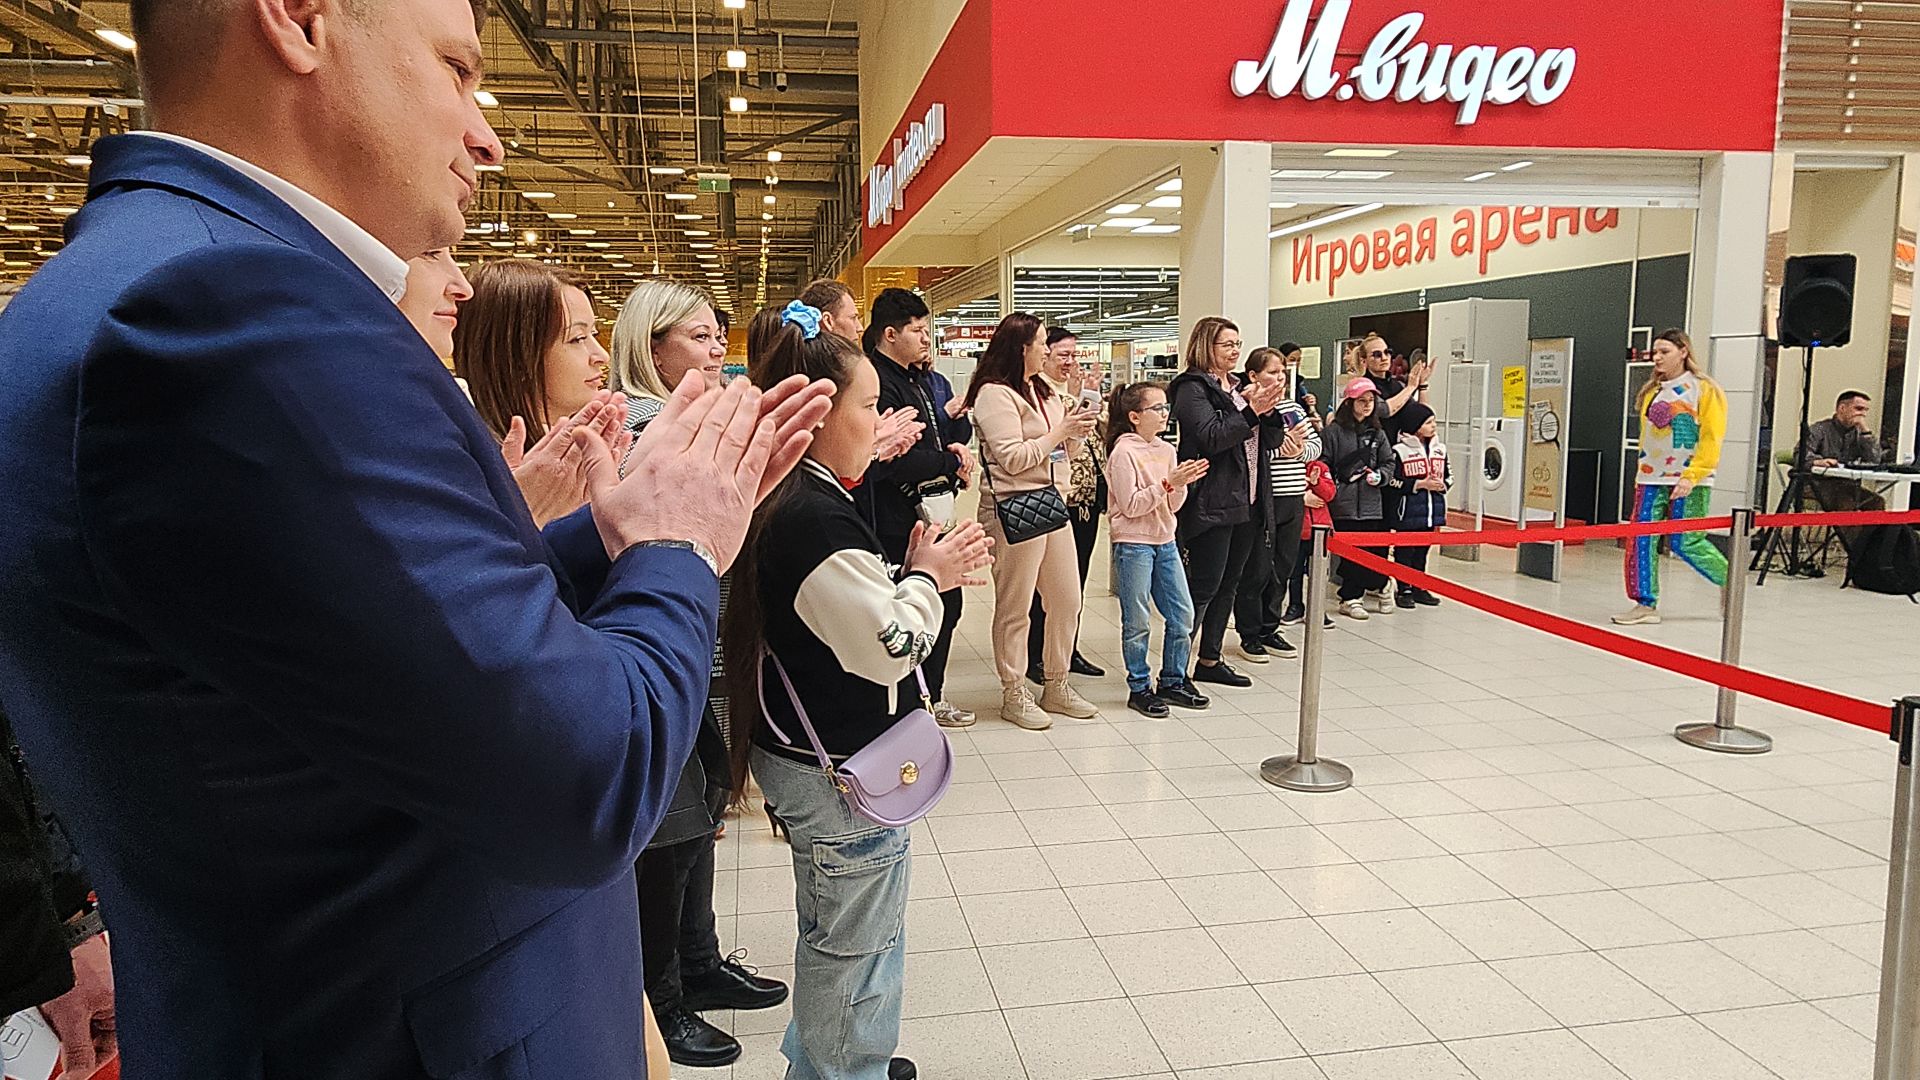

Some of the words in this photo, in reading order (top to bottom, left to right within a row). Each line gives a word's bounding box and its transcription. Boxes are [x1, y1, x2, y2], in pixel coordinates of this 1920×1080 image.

[1231, 0, 1576, 125] М.видео
[1292, 216, 1437, 297] Игровая
[1404, 461, 1427, 477] RUS
